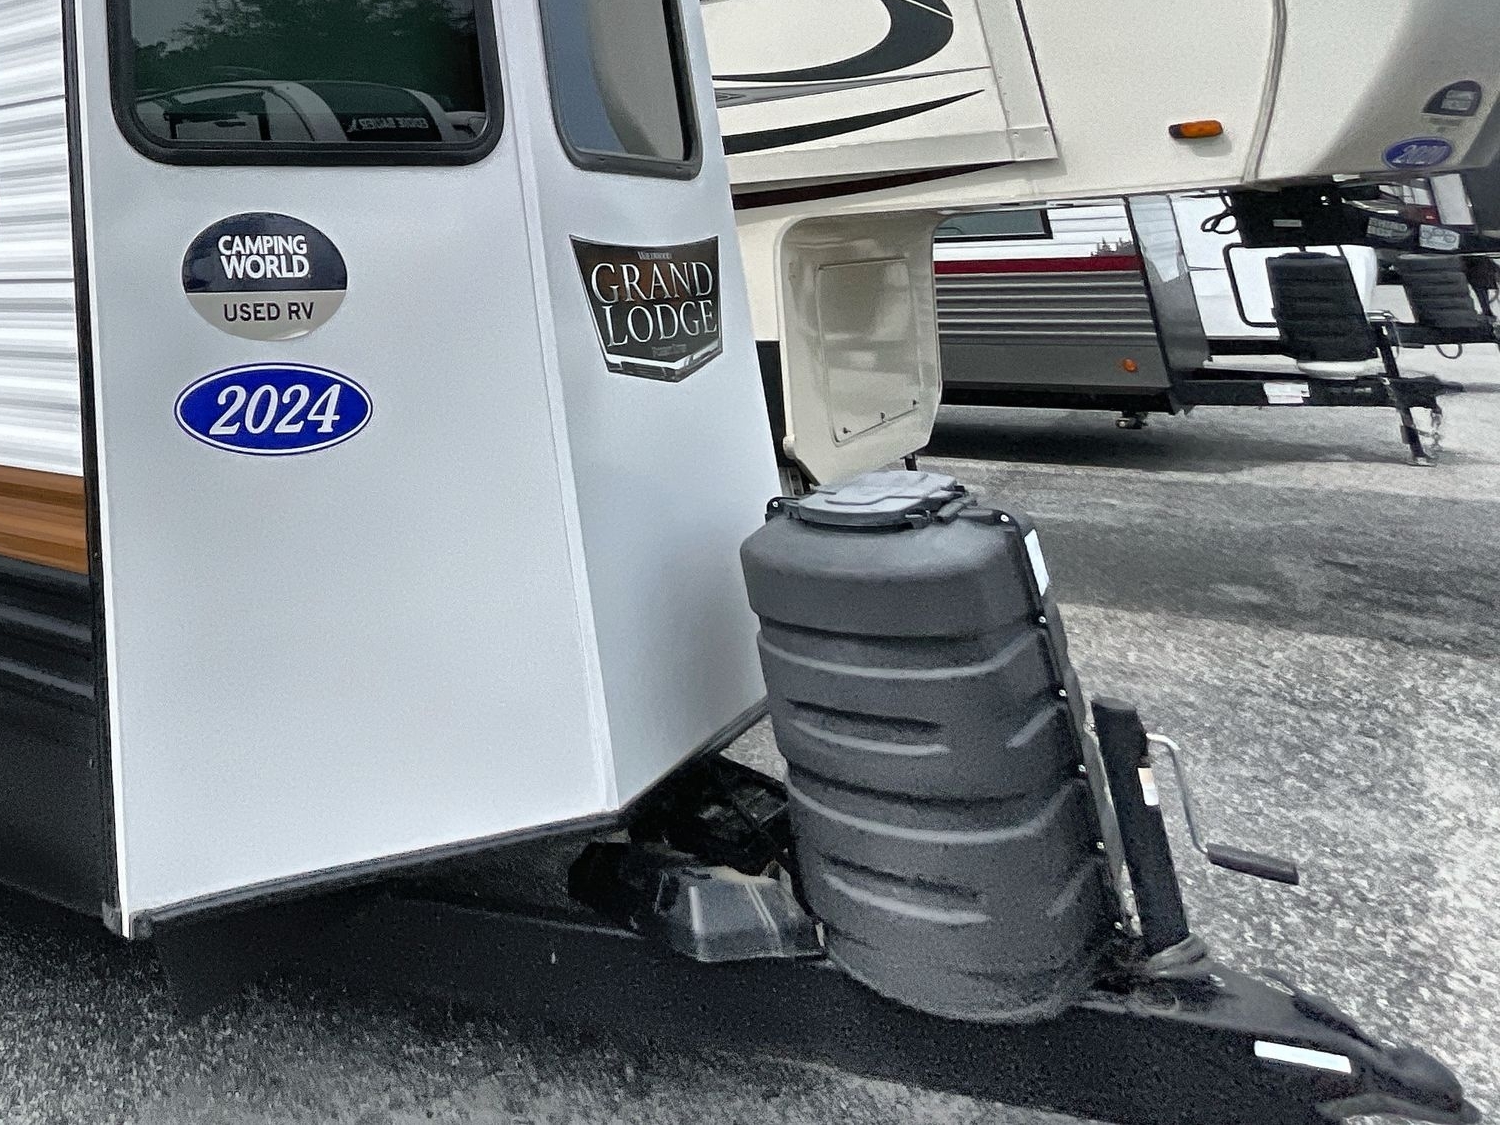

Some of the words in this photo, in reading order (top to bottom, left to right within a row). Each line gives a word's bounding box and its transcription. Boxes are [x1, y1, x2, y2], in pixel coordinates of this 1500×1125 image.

[218, 235, 307, 255] CAMPING
[220, 255, 310, 279] WORLD
[591, 261, 713, 304] GRAND
[224, 302, 280, 322] USED
[287, 302, 314, 320] RV
[602, 300, 718, 347] LODGE
[209, 384, 341, 435] 2024
